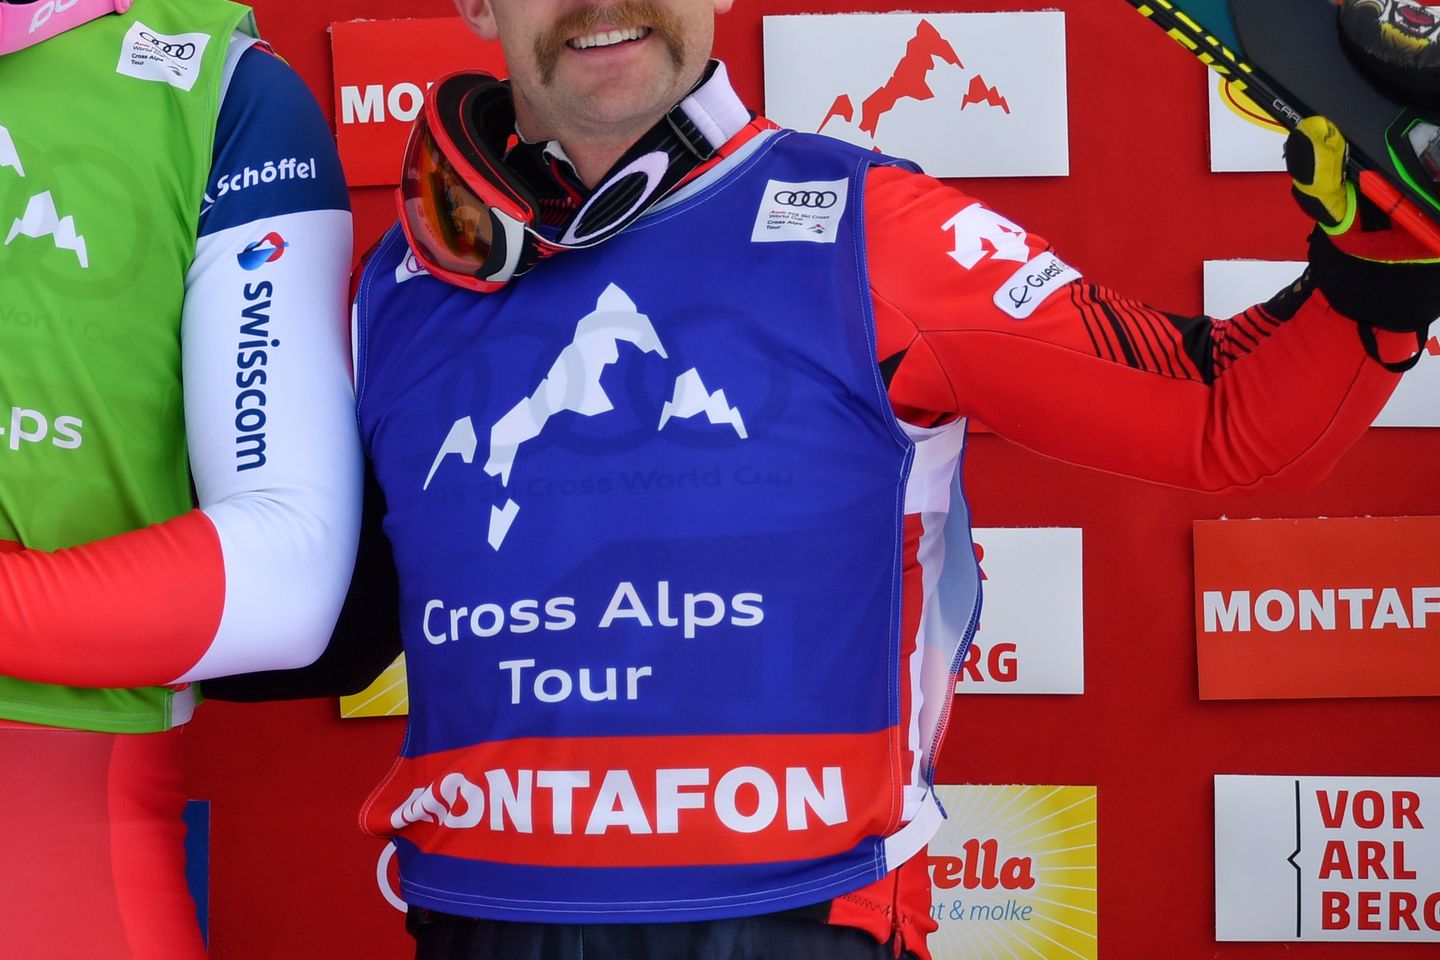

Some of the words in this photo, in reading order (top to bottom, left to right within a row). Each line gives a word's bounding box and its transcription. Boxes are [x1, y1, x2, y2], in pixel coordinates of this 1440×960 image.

[236, 279, 280, 472] swisscom
[422, 596, 576, 645] Cross
[598, 581, 765, 639] Alps
[1202, 586, 1440, 634] MONTAF
[499, 657, 652, 704] Tour
[390, 765, 849, 836] MONTAFON
[1315, 790, 1425, 829] VOR
[1318, 840, 1417, 880] ARL
[949, 899, 964, 921] &
[970, 899, 1032, 921] molke
